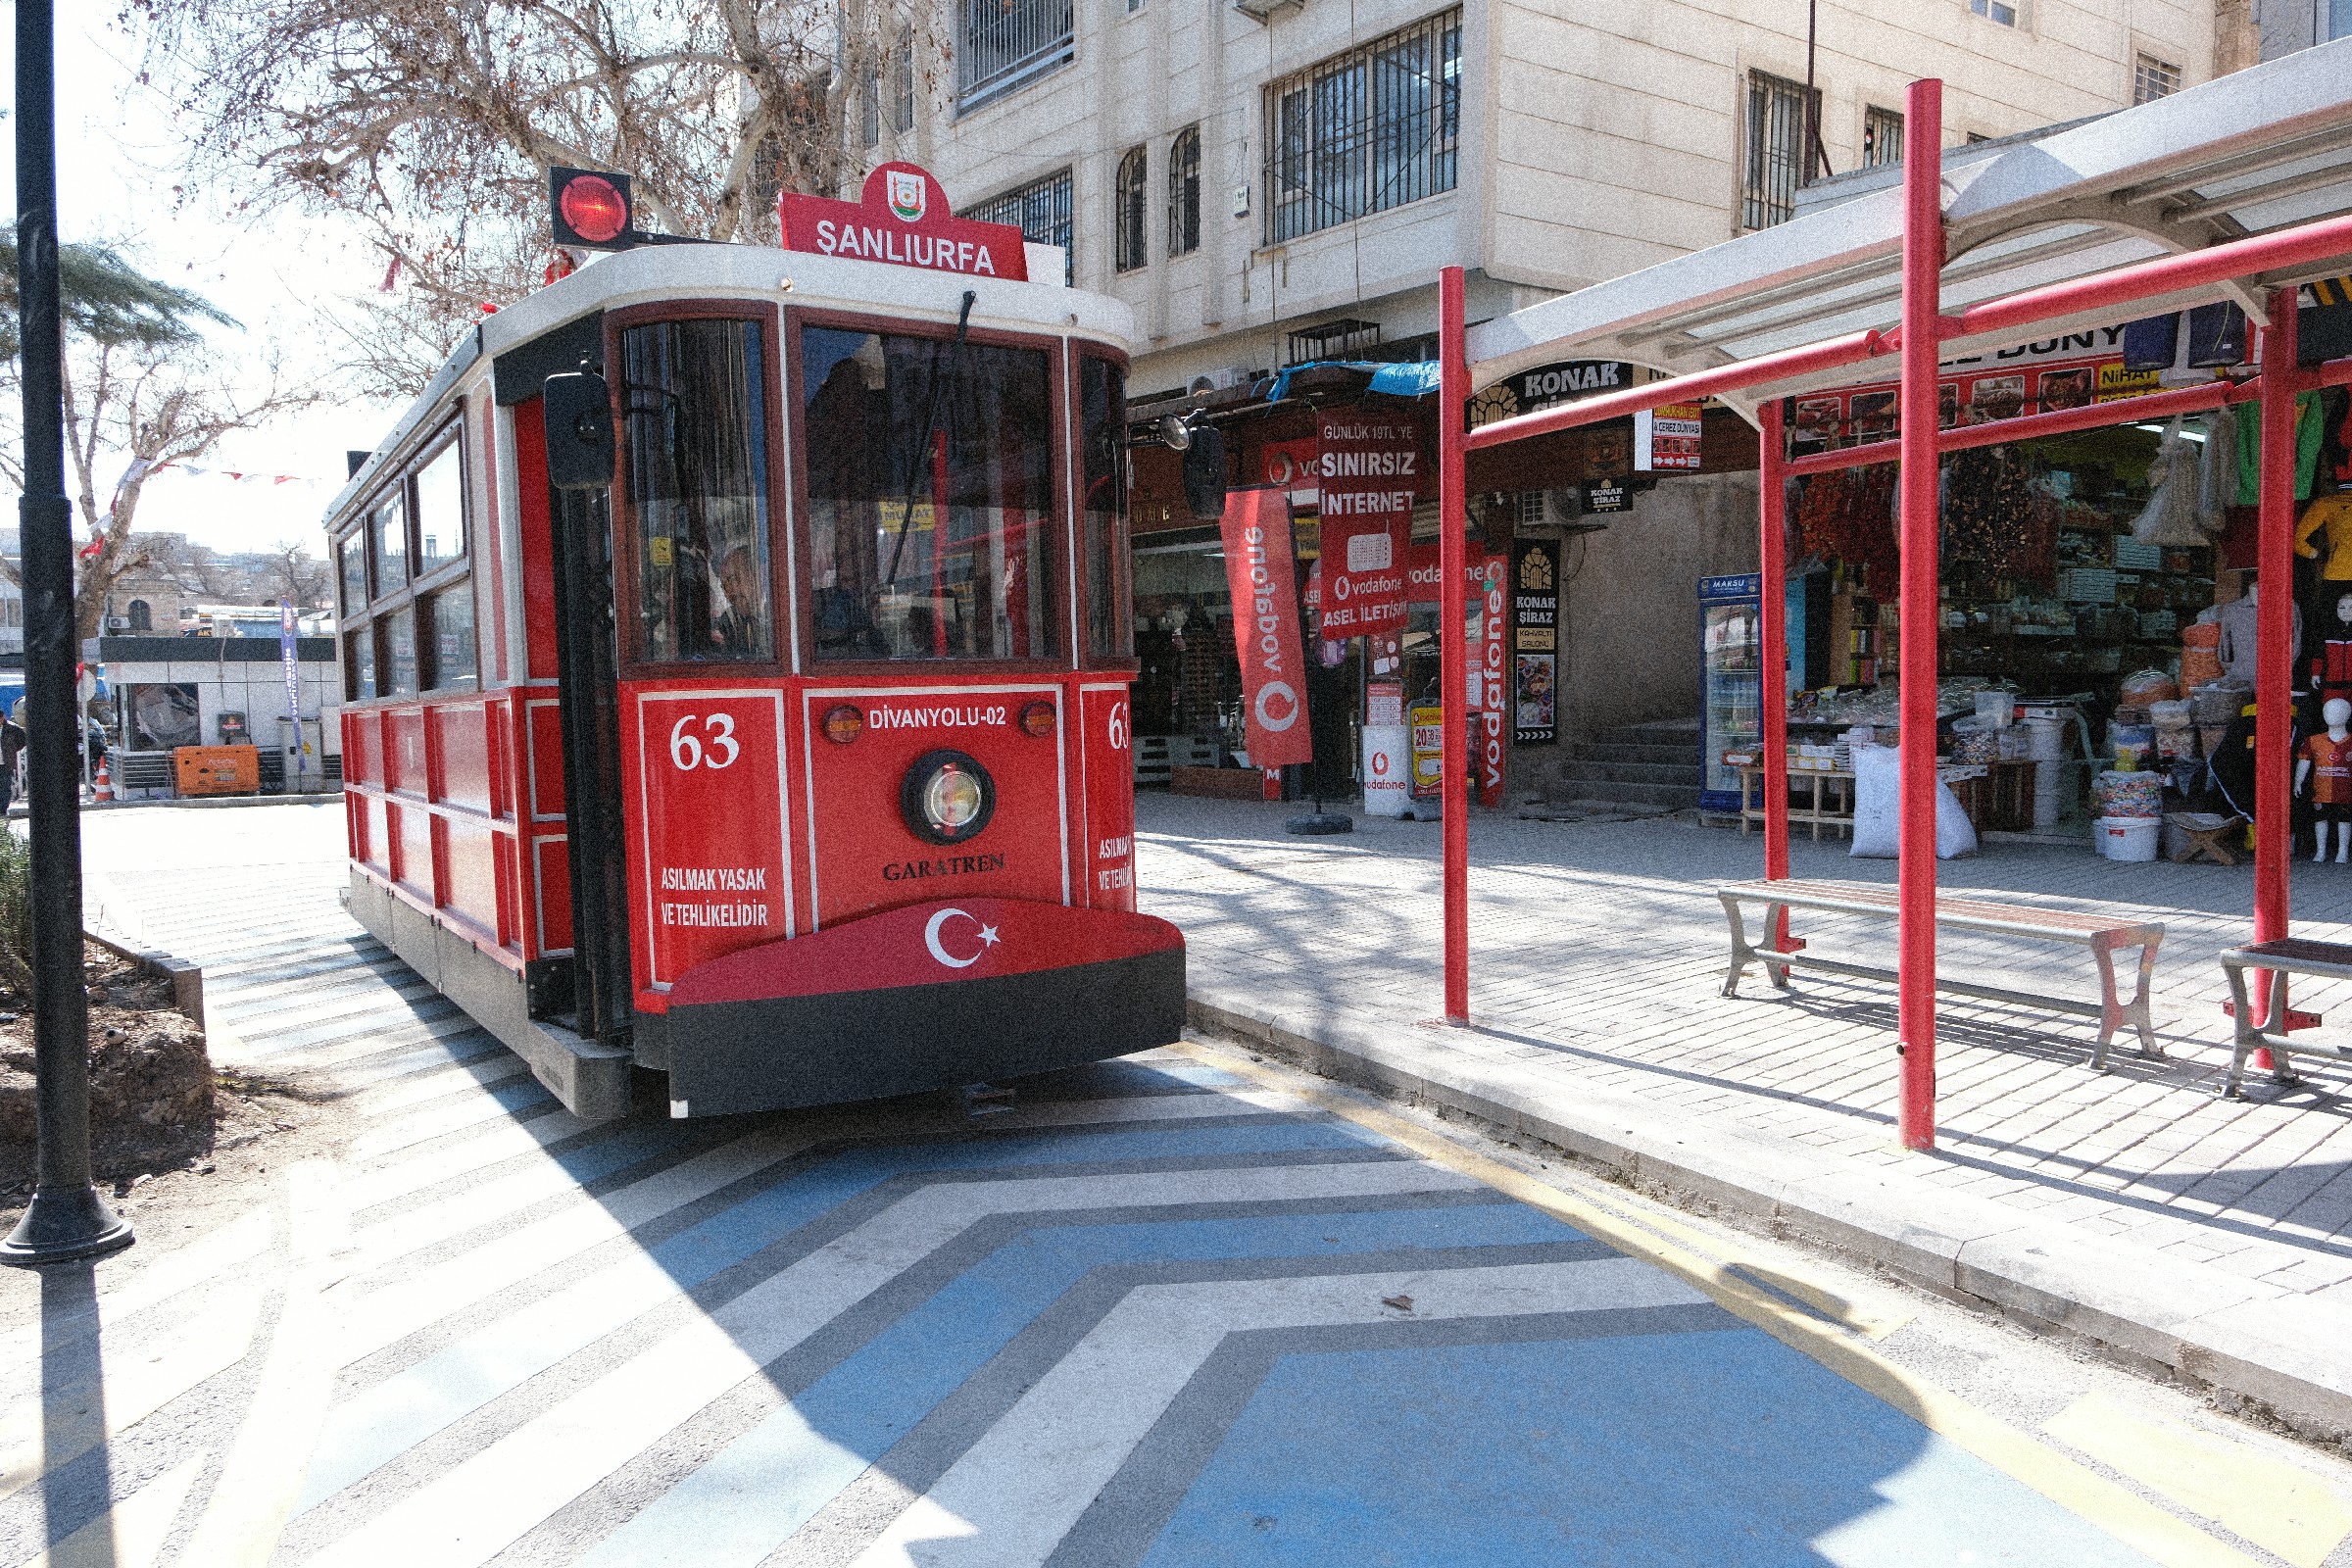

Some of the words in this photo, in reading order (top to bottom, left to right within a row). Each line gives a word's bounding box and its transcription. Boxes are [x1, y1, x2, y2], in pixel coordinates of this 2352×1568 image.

[816, 220, 996, 275] ŞANLIURFA
[1525, 363, 1619, 398] KONAK
[1324, 423, 1369, 440] GÜNLÜK
[1321, 452, 1416, 477] SINIRSIZ
[1321, 489, 1416, 515] İNTERNET
[1591, 487, 1624, 497] KONAK
[1592, 495, 1621, 506] ŞİRAZ
[1352, 575, 1402, 596] vodafone
[1408, 564, 1484, 585] odane
[1516, 596, 1556, 609] KONAK
[1323, 609, 1357, 627] ASEL
[1519, 608, 1553, 625] ŞİRAZ
[1483, 589, 1502, 789] vodafone
[869, 704, 1006, 729] DİVANYOLU-02
[670, 712, 740, 771] 63
[661, 866, 716, 891] ASILMAK
[718, 867, 766, 891] YASAK
[883, 853, 1004, 881] GARATREN
[1099, 870, 1110, 891] VE
[662, 902, 675, 925] VE
[675, 898, 768, 927] TEHLİKELİDİR
